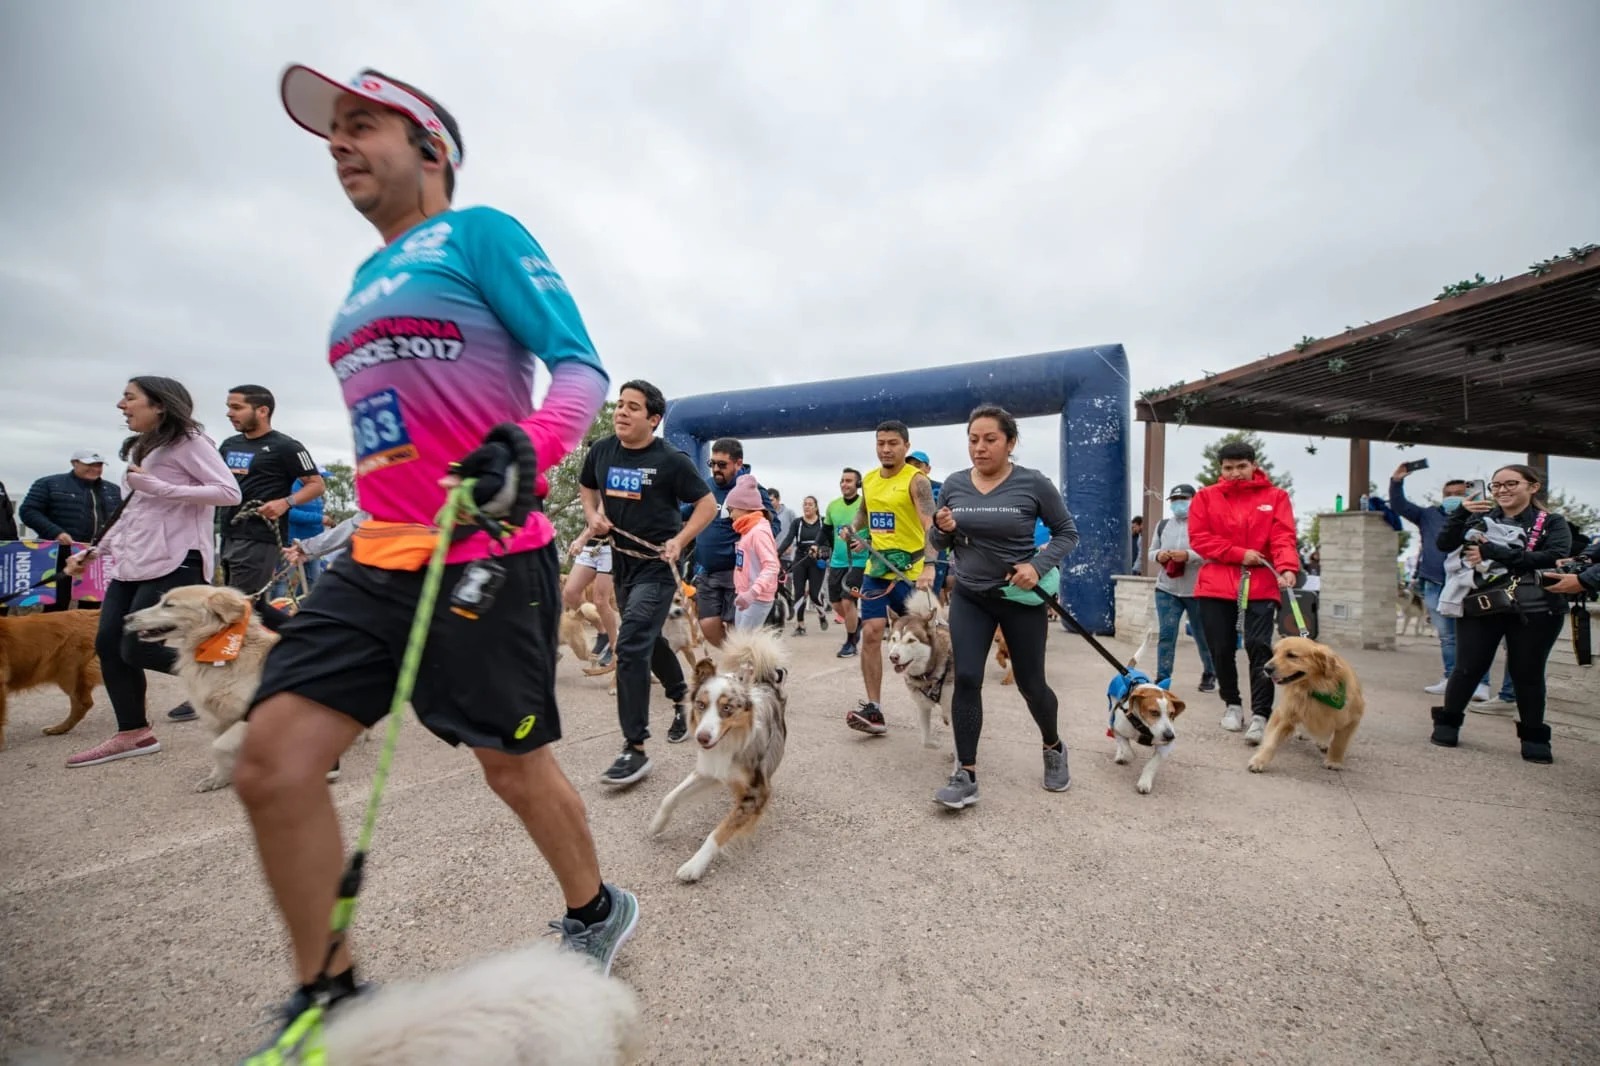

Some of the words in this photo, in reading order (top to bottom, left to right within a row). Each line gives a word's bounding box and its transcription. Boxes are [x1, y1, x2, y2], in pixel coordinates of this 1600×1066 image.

[228, 455, 249, 469] 026
[611, 475, 640, 490] 049
[872, 517, 893, 528] 054
